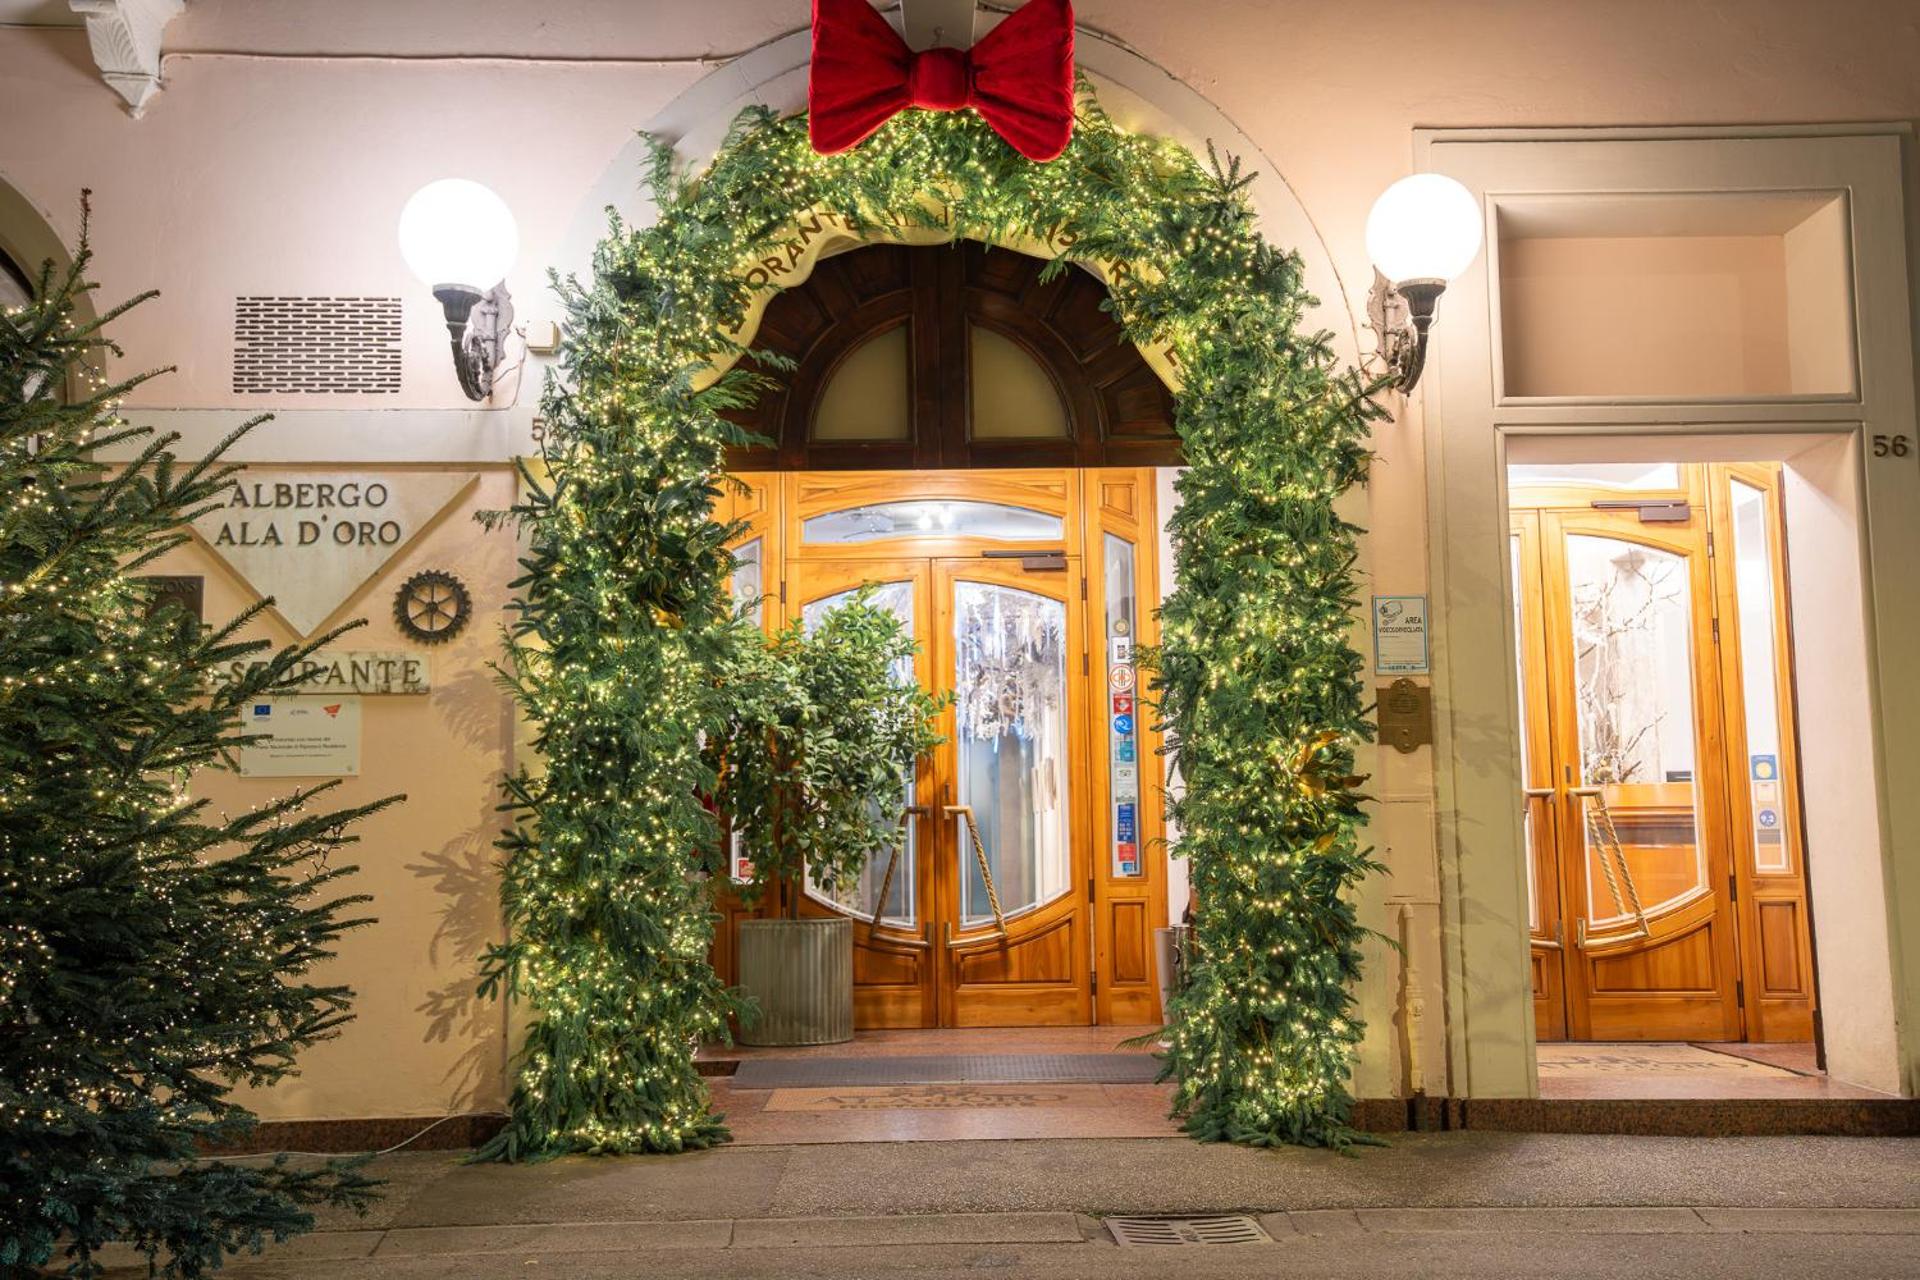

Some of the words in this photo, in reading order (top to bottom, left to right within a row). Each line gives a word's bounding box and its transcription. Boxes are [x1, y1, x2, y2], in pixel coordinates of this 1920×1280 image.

[1873, 435, 1908, 458] 56
[229, 483, 388, 508] ALBERGO
[215, 522, 283, 546] ALA
[298, 514, 402, 546] D'ORO
[1404, 616, 1423, 625] AREA
